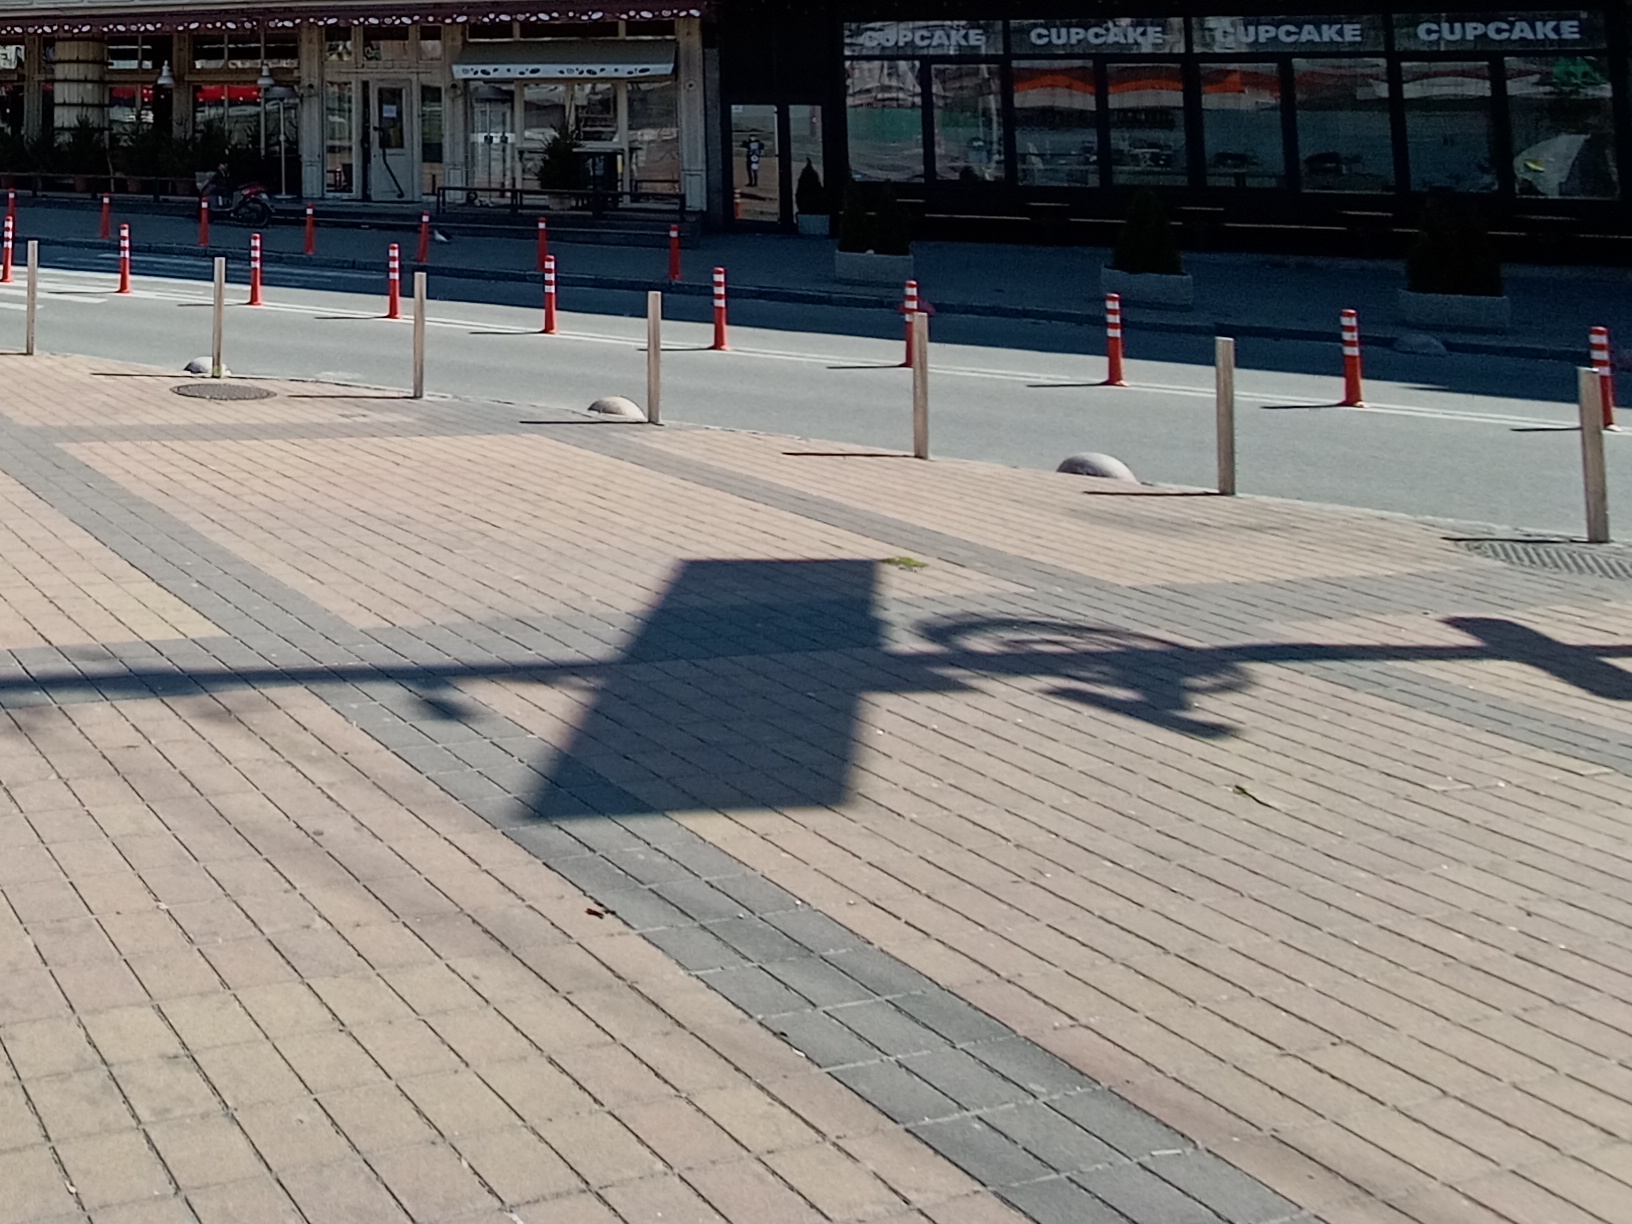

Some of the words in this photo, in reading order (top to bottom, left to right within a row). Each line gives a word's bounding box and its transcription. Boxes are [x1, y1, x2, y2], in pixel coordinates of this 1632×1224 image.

[862, 28, 985, 48] CUPCAKE
[1029, 26, 1164, 46] CUPCAKE
[1216, 23, 1362, 45] CUPCAKE
[1416, 20, 1581, 42] CUPCAKE
